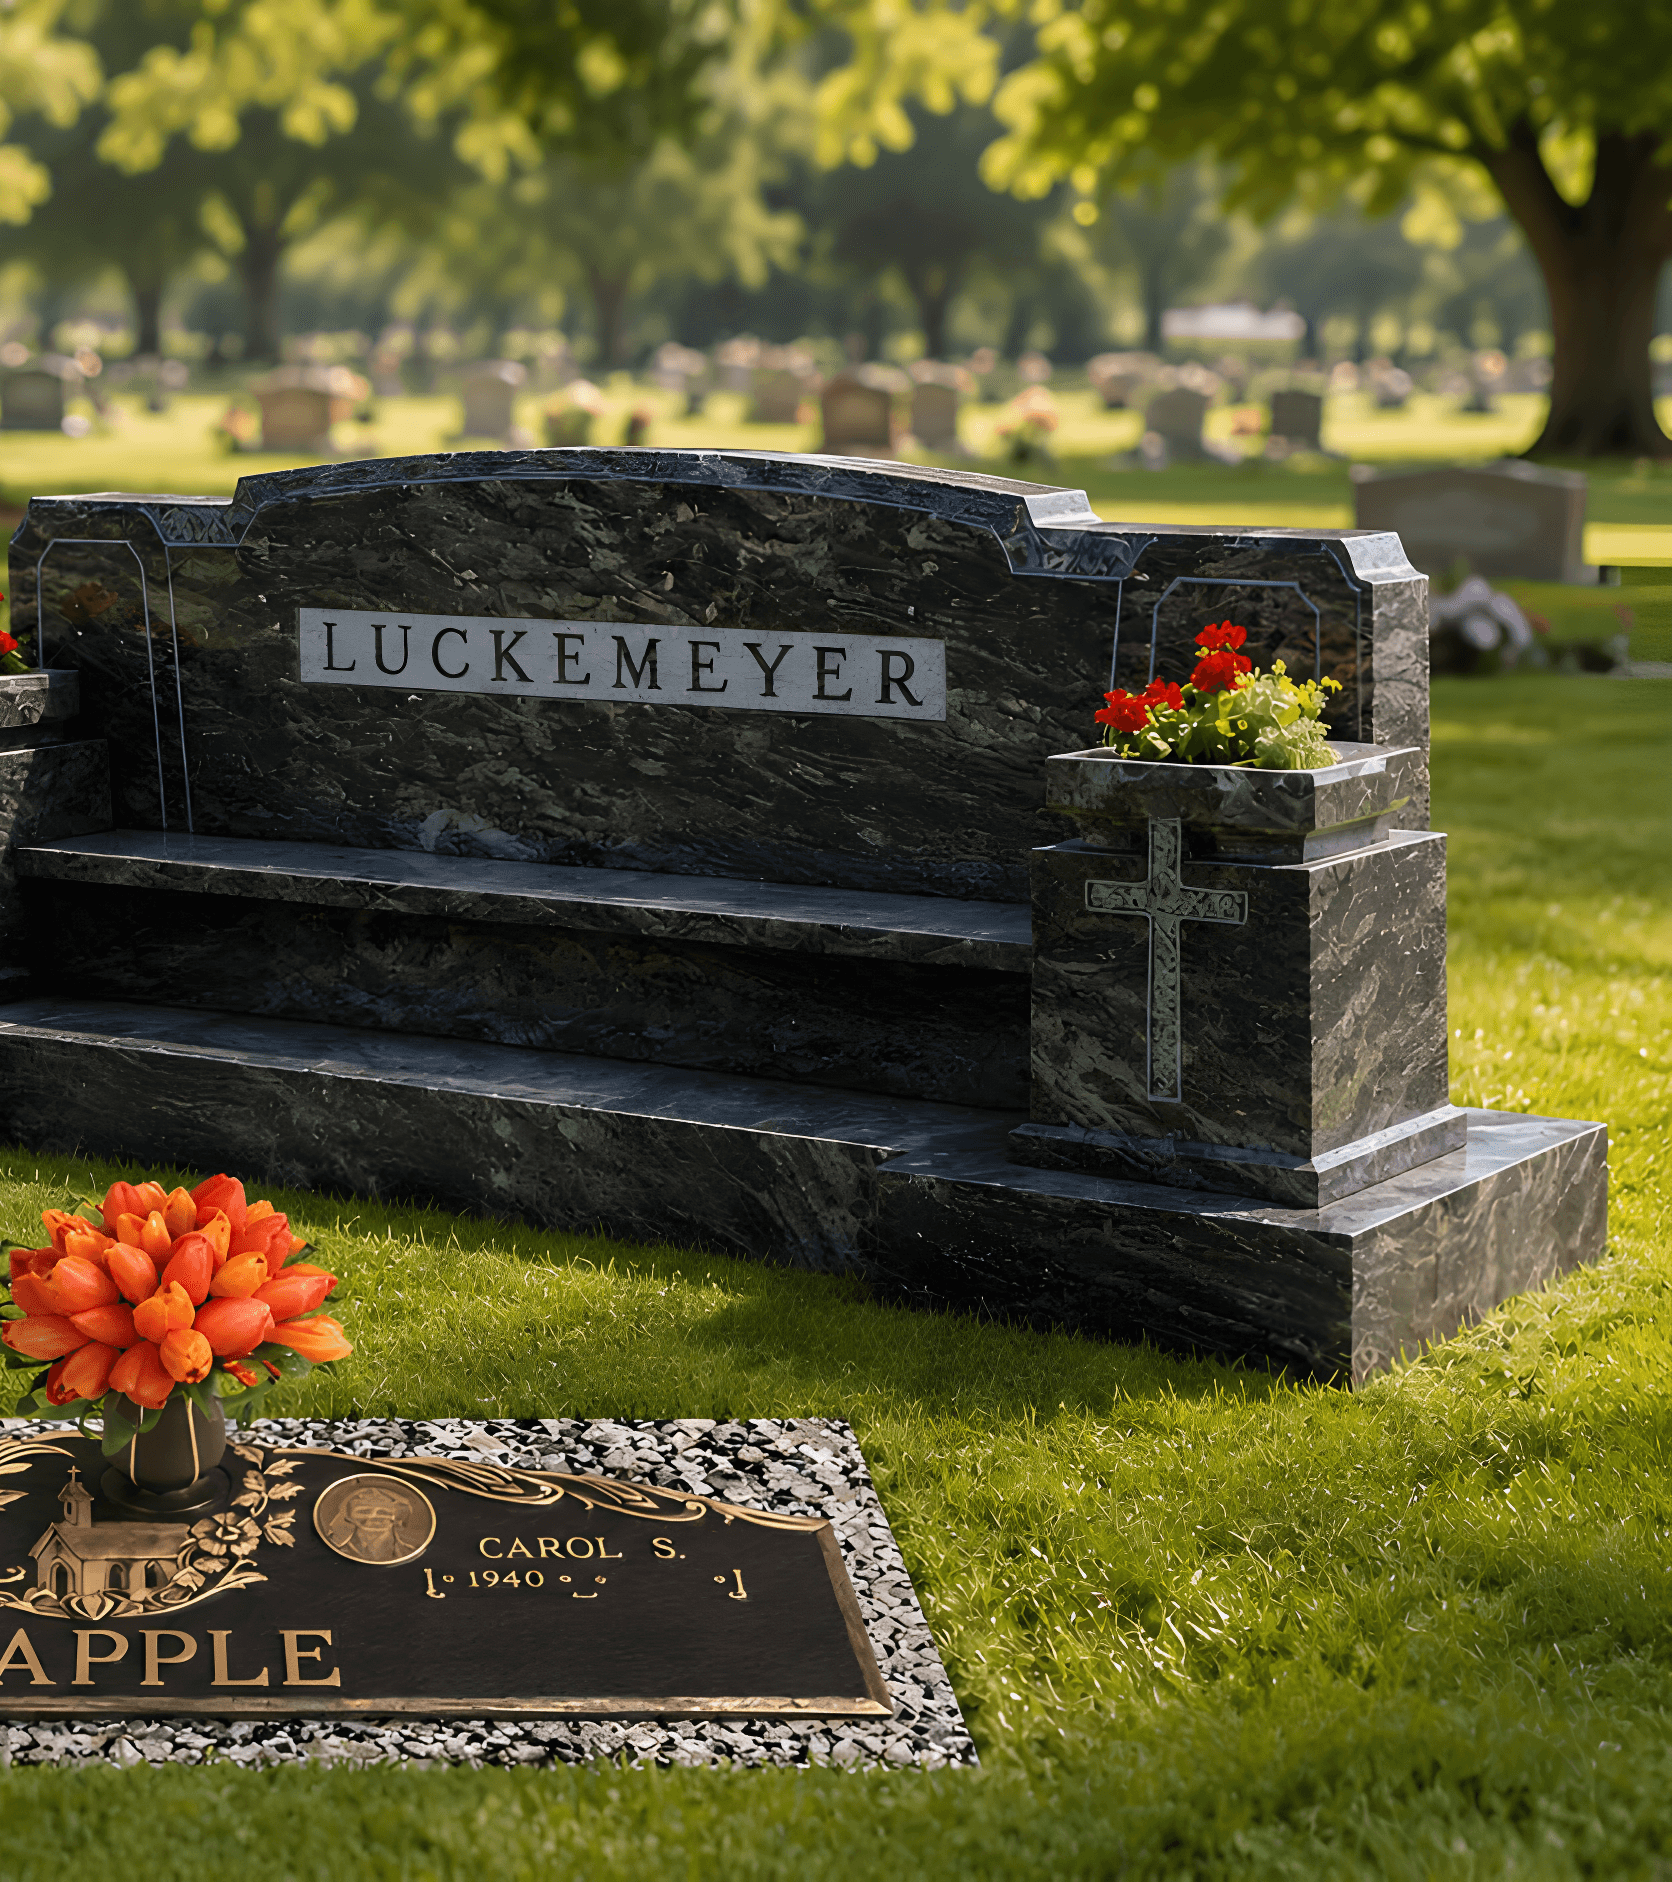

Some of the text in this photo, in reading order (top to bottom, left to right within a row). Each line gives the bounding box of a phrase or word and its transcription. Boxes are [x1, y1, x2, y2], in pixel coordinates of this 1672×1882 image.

[322, 622, 923, 706] LUCKEMEYER
[479, 1537, 687, 1559] CAROL S.
[469, 1570, 544, 1588] 1940
